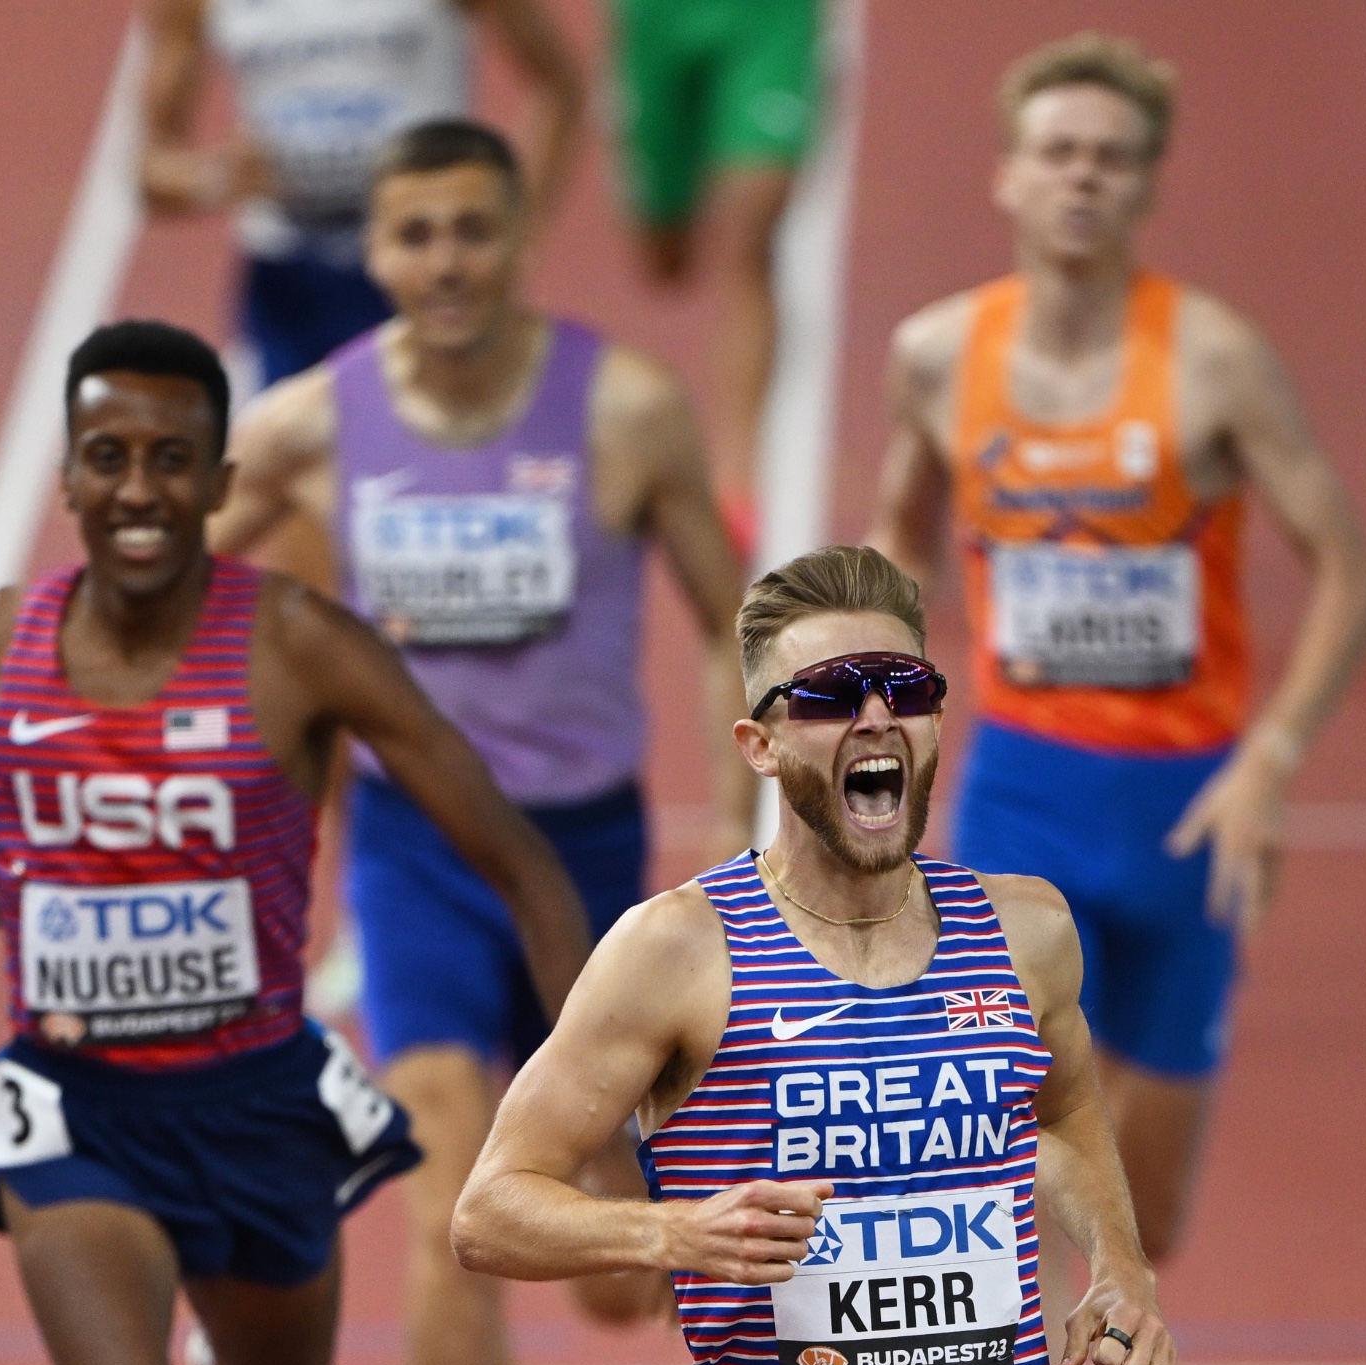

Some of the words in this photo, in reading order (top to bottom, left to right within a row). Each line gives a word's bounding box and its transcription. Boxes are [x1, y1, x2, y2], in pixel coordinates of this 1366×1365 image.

[12, 771, 235, 851] USA
[78, 891, 229, 941] TDK
[38, 945, 238, 1002] NUGUSE
[776, 1059, 1009, 1118] GREAT
[777, 1113, 1011, 1172] BRITAIN
[841, 1199, 1004, 1261] TDK
[828, 1271, 977, 1335] KERR
[988, 1338, 1008, 1359] 23
